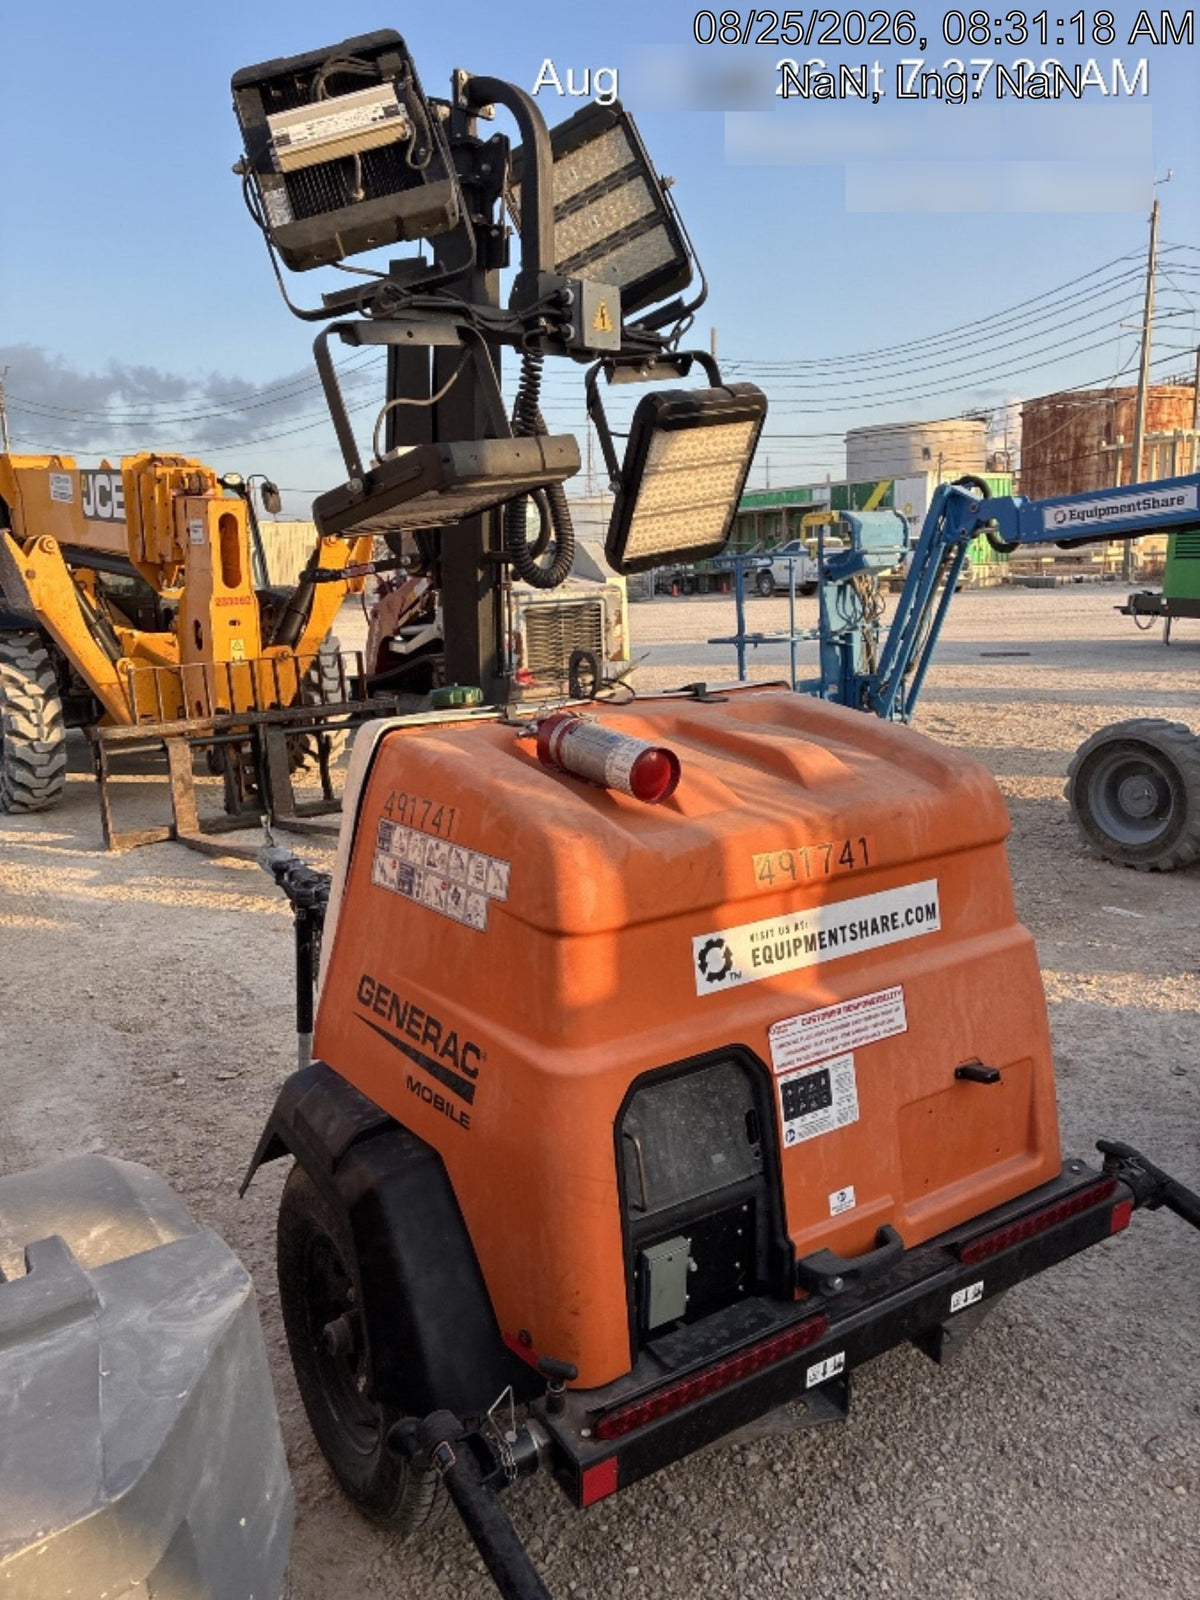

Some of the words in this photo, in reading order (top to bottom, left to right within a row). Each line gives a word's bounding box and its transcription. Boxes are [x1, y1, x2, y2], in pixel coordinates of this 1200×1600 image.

[1068, 495, 1186, 521] EquipmentShare
[384, 790, 456, 837] 491741
[758, 837, 869, 885] 491741
[750, 928, 774, 942] VISIT
[778, 924, 790, 936] US
[752, 902, 937, 968] EQUIPMENTSHARE.COM
[356, 973, 481, 1080] GENERAC
[406, 1075, 471, 1131] MOBILE
